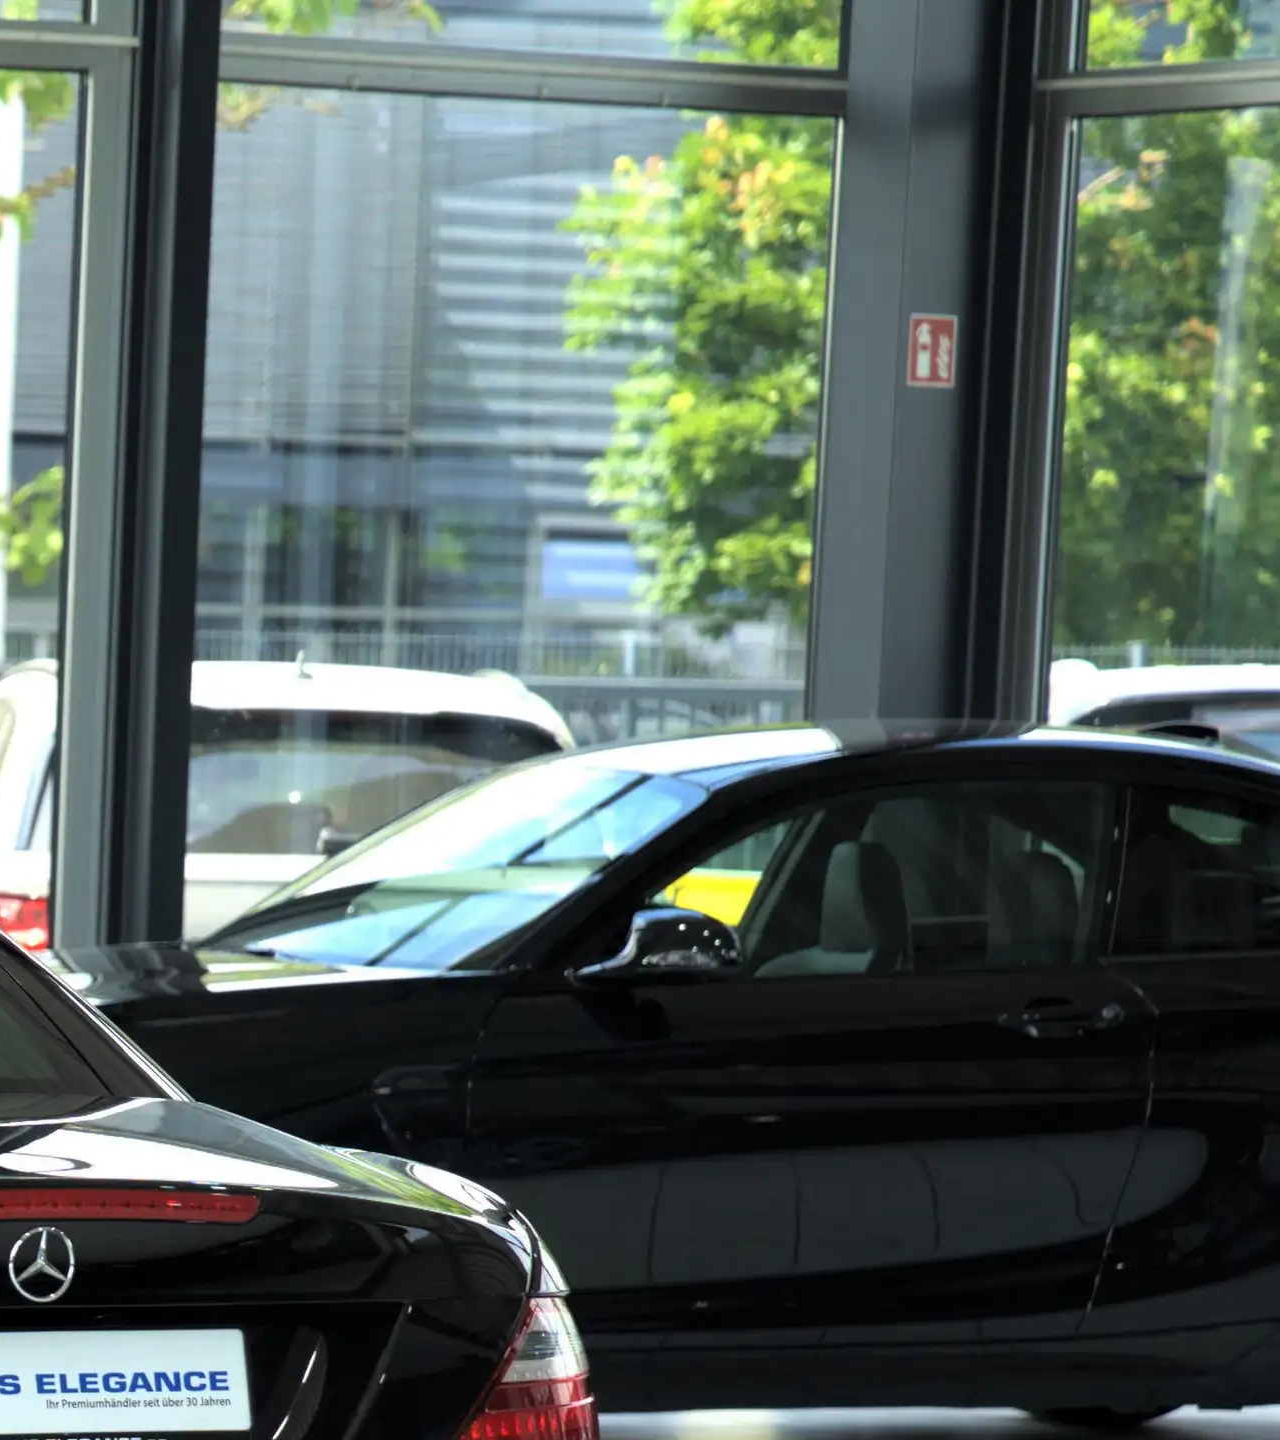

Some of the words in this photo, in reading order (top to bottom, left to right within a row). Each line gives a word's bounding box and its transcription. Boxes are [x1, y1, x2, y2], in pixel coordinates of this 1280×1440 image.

[35, 1371, 230, 1394] ELEGANCE
[46, 1398, 60, 1409] Ihr
[62, 1397, 141, 1409] Premiumhändler
[143, 1398, 160, 1408] seit
[162, 1397, 184, 1408] über
[186, 1397, 198, 1407] 30
[200, 1397, 232, 1407] Jahren
